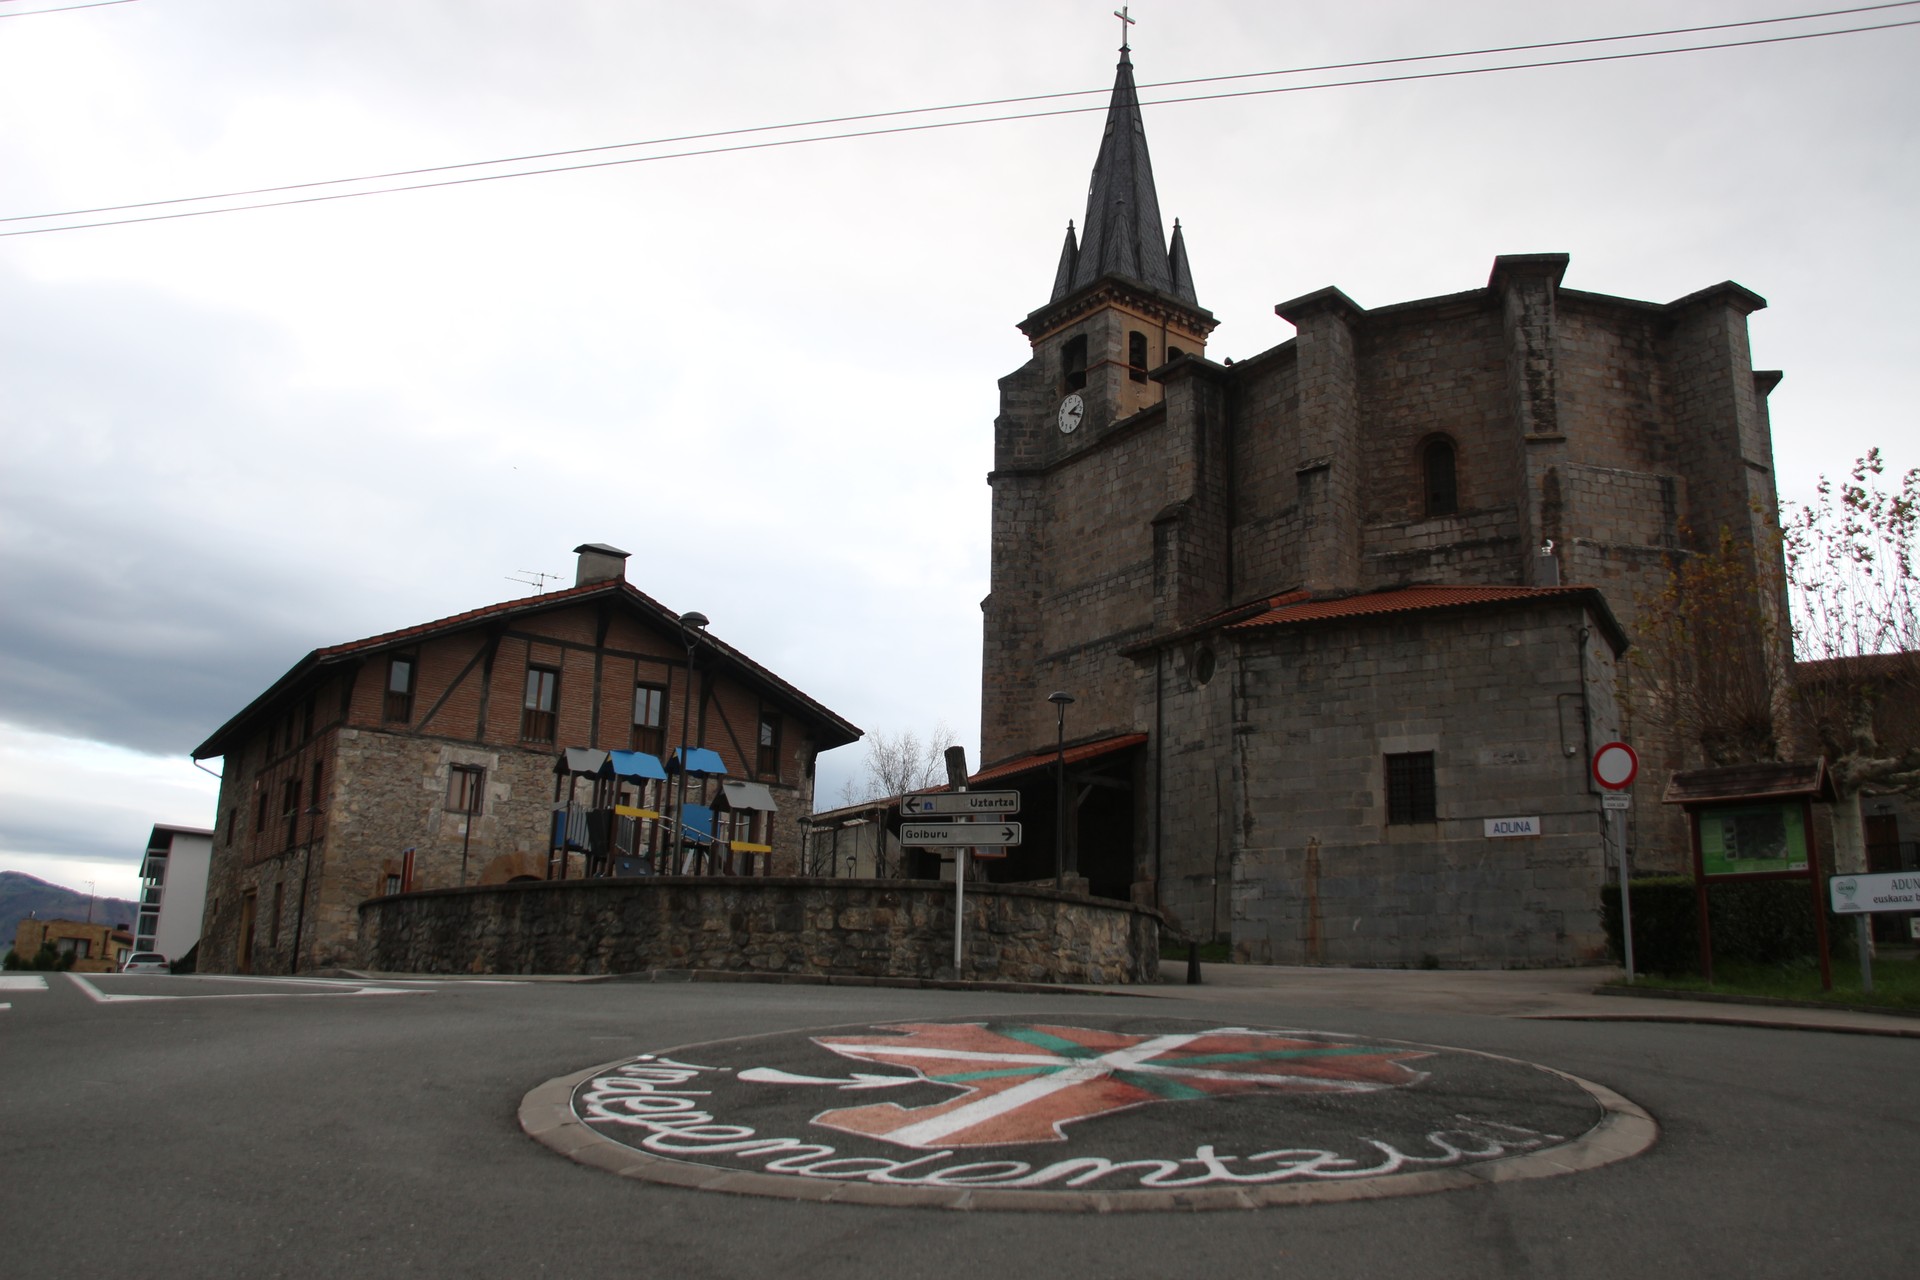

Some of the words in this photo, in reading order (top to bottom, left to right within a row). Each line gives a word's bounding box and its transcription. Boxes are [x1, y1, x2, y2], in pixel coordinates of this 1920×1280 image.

[970, 798, 1014, 808] Uztartza
[1493, 821, 1531, 834] ADUNA
[905, 829, 948, 839] Goiburu
[1873, 894, 1913, 903] euskaraz
